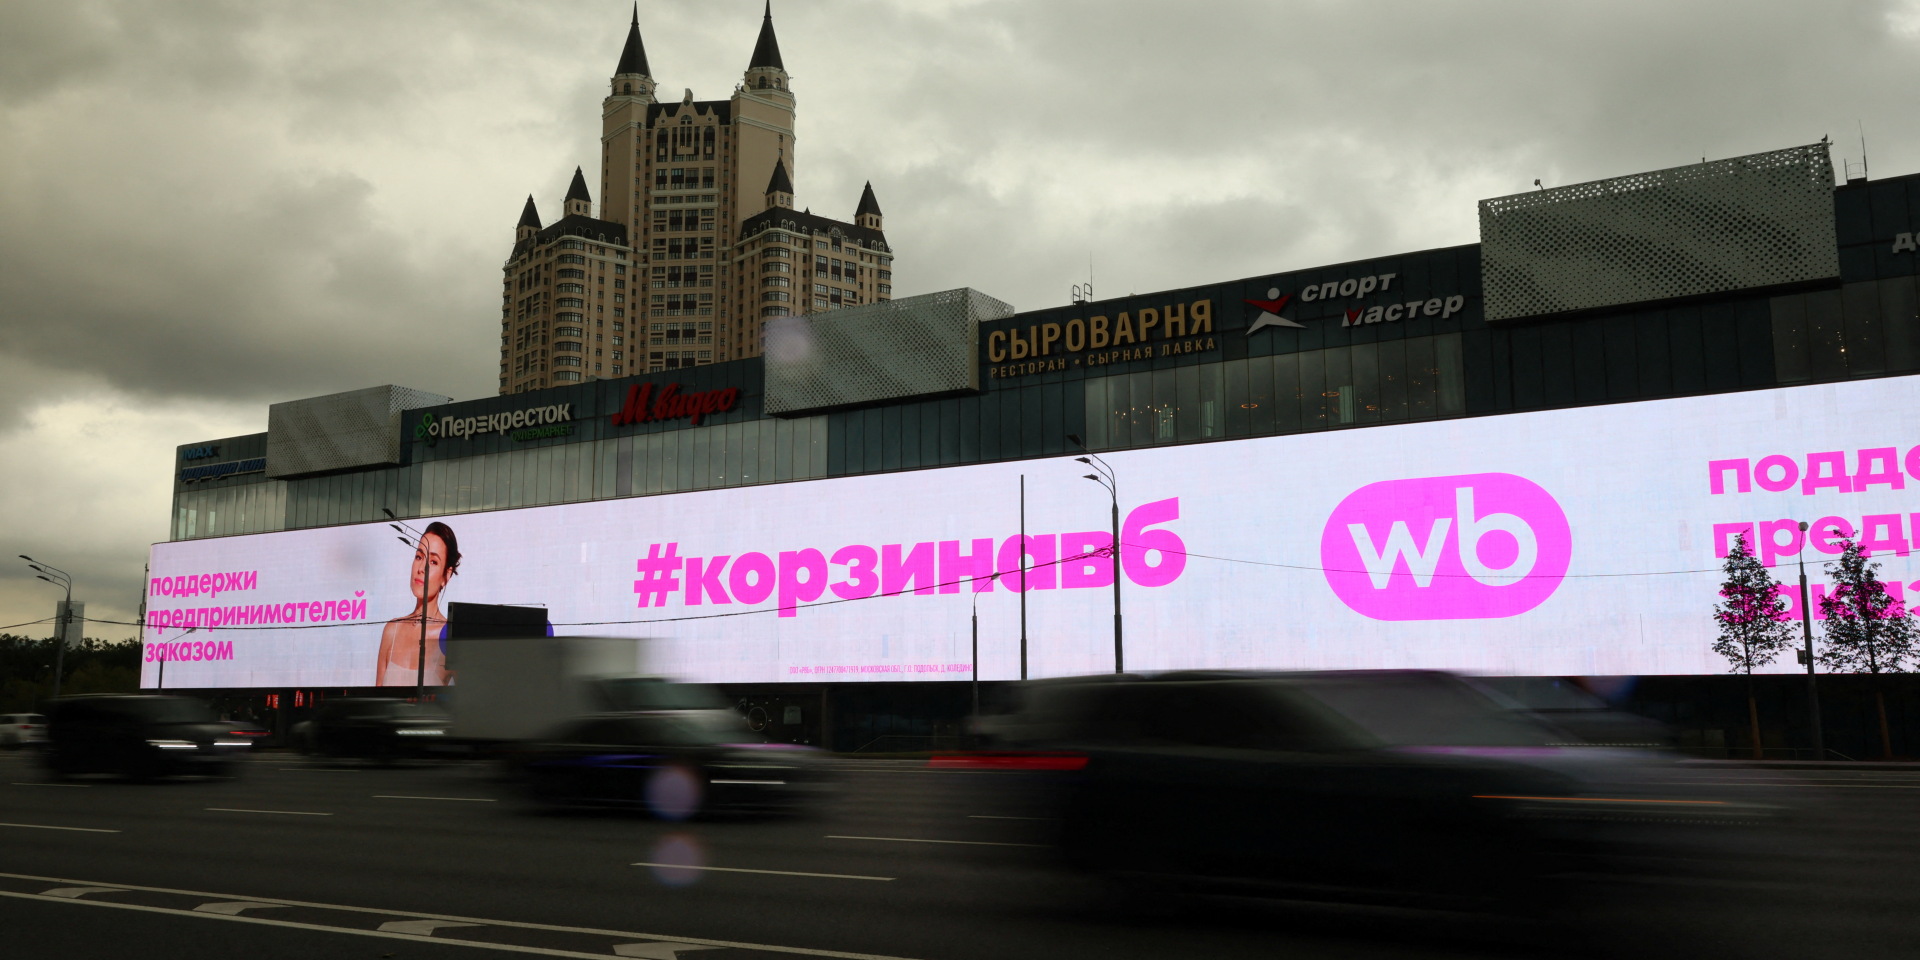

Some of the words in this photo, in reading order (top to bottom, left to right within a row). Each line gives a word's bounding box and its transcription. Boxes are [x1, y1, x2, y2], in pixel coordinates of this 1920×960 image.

[988, 299, 1213, 364] СЫРОВАРНЯ
[990, 358, 1066, 378] РЕСТОРАН
[1088, 345, 1153, 366] СЫРНАЯ
[1161, 338, 1215, 357] ЛАВКА
[441, 403, 571, 441] Перекресток
[511, 424, 571, 442] СУПЕРМАРКЕТ
[181, 445, 214, 460] IMAX
[634, 497, 1187, 618] #корзинавб
[1347, 487, 1538, 590] wb
[1713, 512, 1920, 568] пред
[150, 570, 257, 598] поддержи
[147, 590, 367, 634] предпринимателей
[145, 640, 233, 663] заказом
